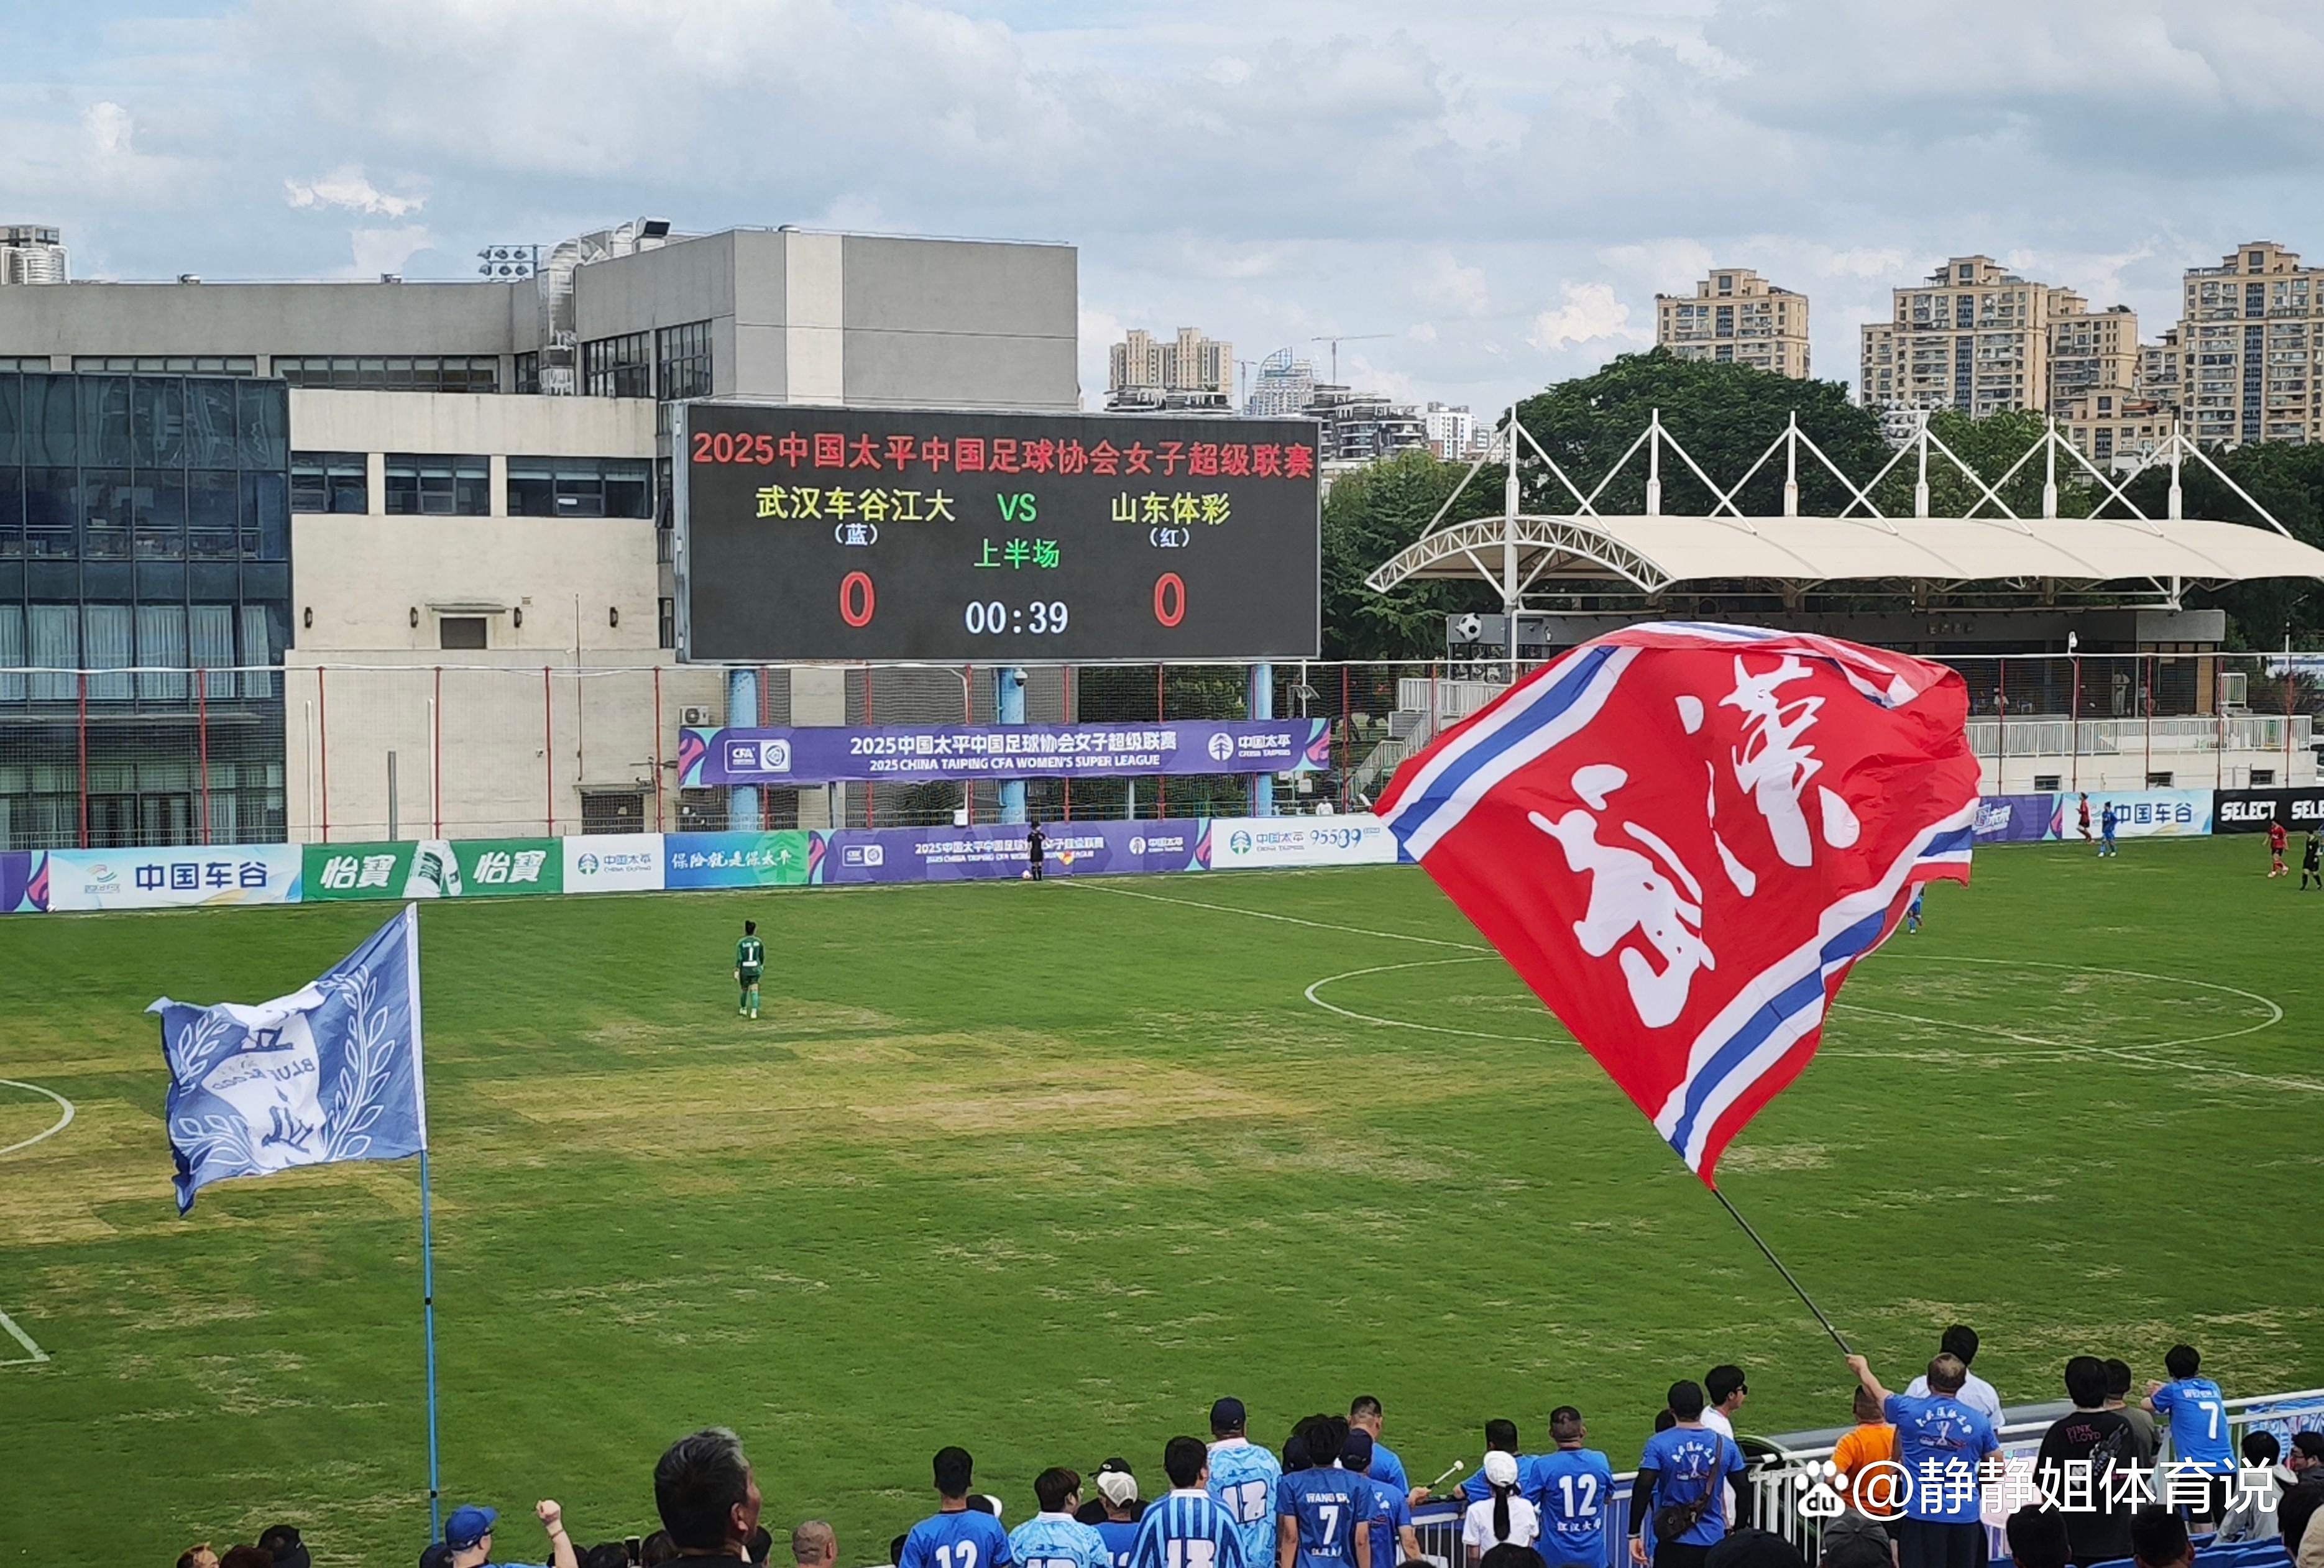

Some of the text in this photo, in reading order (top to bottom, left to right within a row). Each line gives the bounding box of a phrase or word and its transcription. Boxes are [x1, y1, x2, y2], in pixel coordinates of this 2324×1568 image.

[692, 432, 1314, 479] 2025中国太平中国足球协会女子超级联赛
[756, 484, 955, 523] 武汉车谷江大
[997, 493, 1037, 522] VS
[1112, 492, 1231, 525] 山东体彩
[974, 539, 1060, 569] 上半场
[839, 571, 875, 627] 0
[1154, 572, 1185, 627] 0
[965, 601, 1068, 635] 00:39
[850, 731, 1177, 755] 2025中国太平中国足球协会女子超级联赛
[1238, 734, 1291, 748] 中国太平
[870, 754, 1160, 771] 2025 CHINA TAIPING CFA WOMEN'S SUPER LEAGUE
[2114, 802, 2192, 824] 中国车谷
[2221, 800, 2277, 821] SELECT
[1310, 828, 1362, 849] 95589
[136, 862, 267, 891] 中国车谷
[749, 947, 753, 961] 1
[2198, 1401, 2219, 1439] 7
[1559, 1474, 1597, 1517] 12
[1319, 1505, 1339, 1545] 7
[935, 1539, 978, 1568] 12
